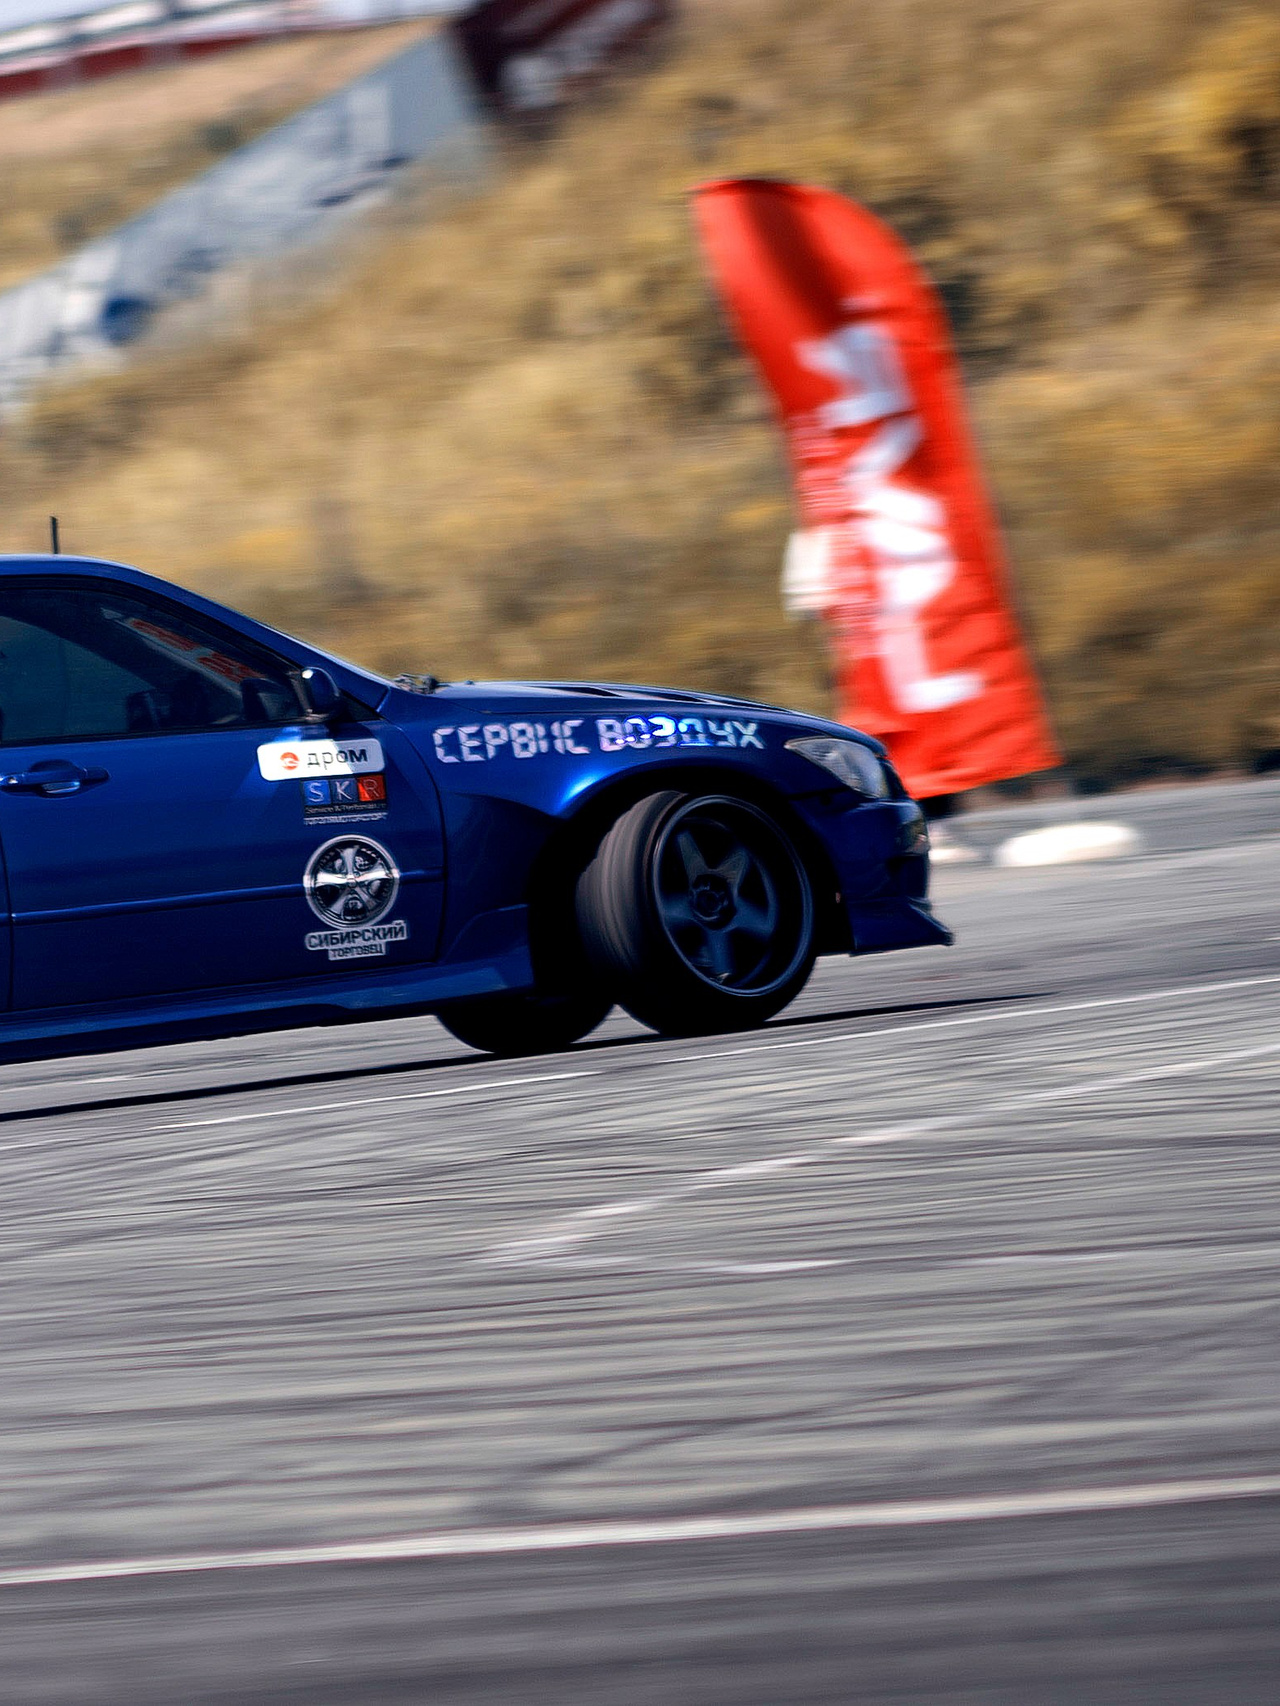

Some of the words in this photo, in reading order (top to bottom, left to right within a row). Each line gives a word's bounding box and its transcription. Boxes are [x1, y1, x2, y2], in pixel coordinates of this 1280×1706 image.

[432, 719, 591, 763] СЕРВИС
[595, 715, 765, 752] ВОЗДУХ
[307, 777, 381, 802] SKR
[308, 923, 405, 949] СИБИРСКИЙ
[331, 943, 384, 958] ТОРГОВЕЦ
